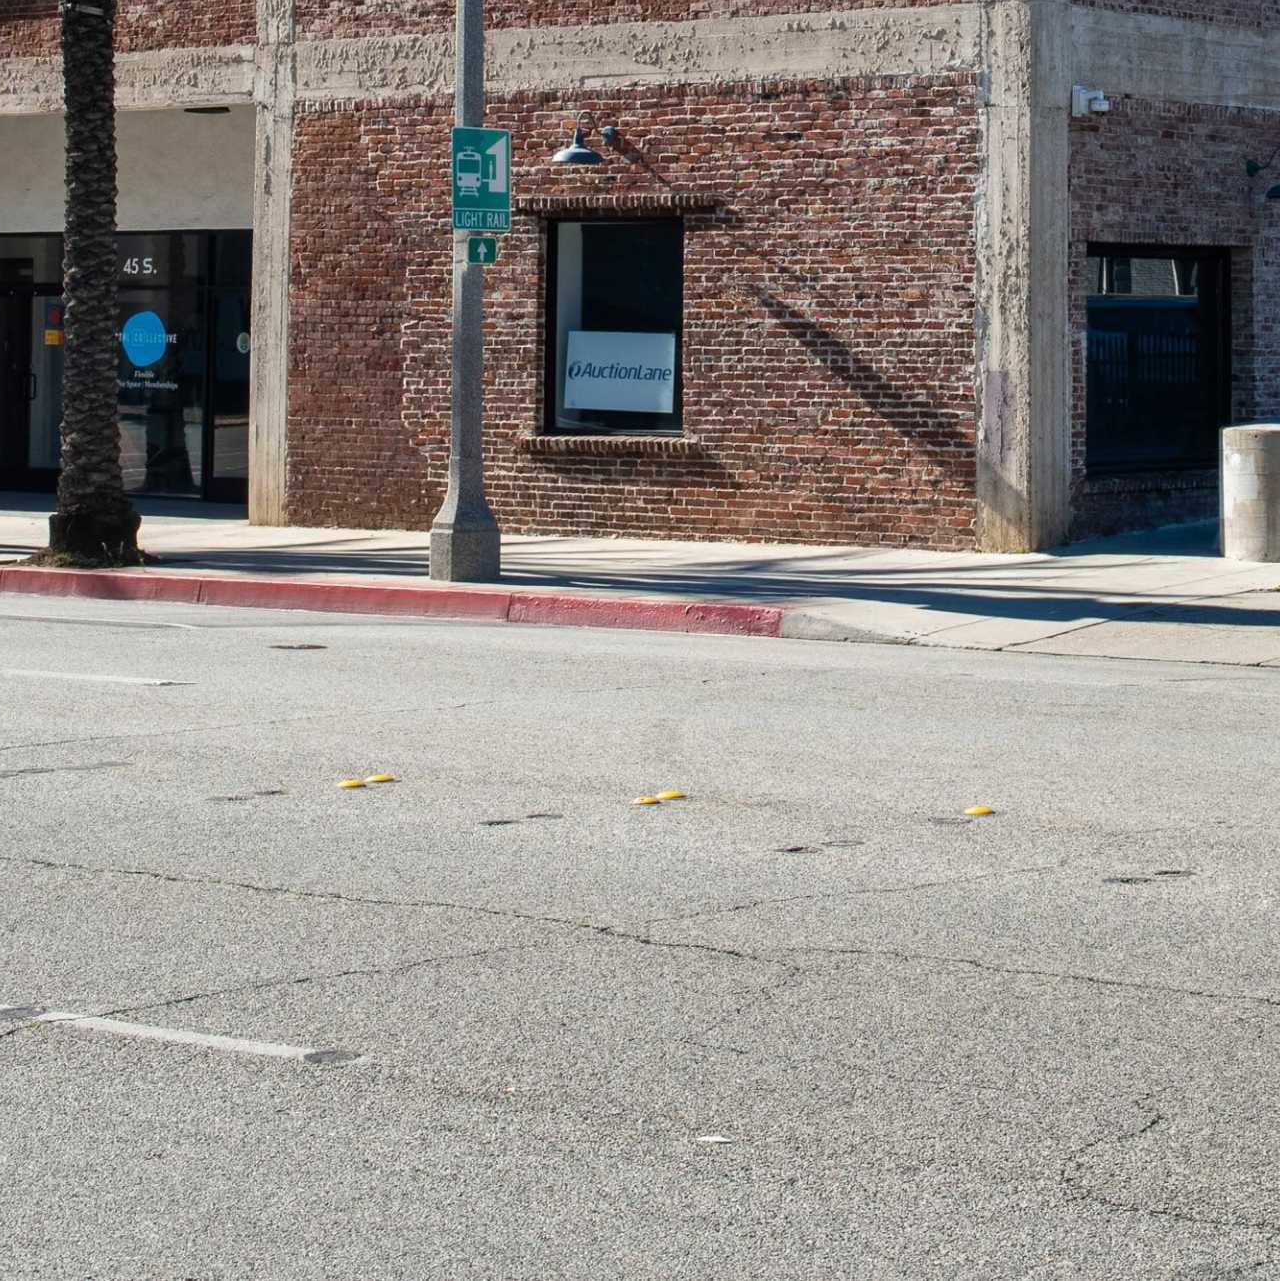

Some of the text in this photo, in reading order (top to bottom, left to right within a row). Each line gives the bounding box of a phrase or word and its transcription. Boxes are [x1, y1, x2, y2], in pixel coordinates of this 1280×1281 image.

[455, 210, 509, 228] LIGHT RAIL
[123, 258, 157, 275] 45 S.
[581, 362, 672, 381] AuctionLane
